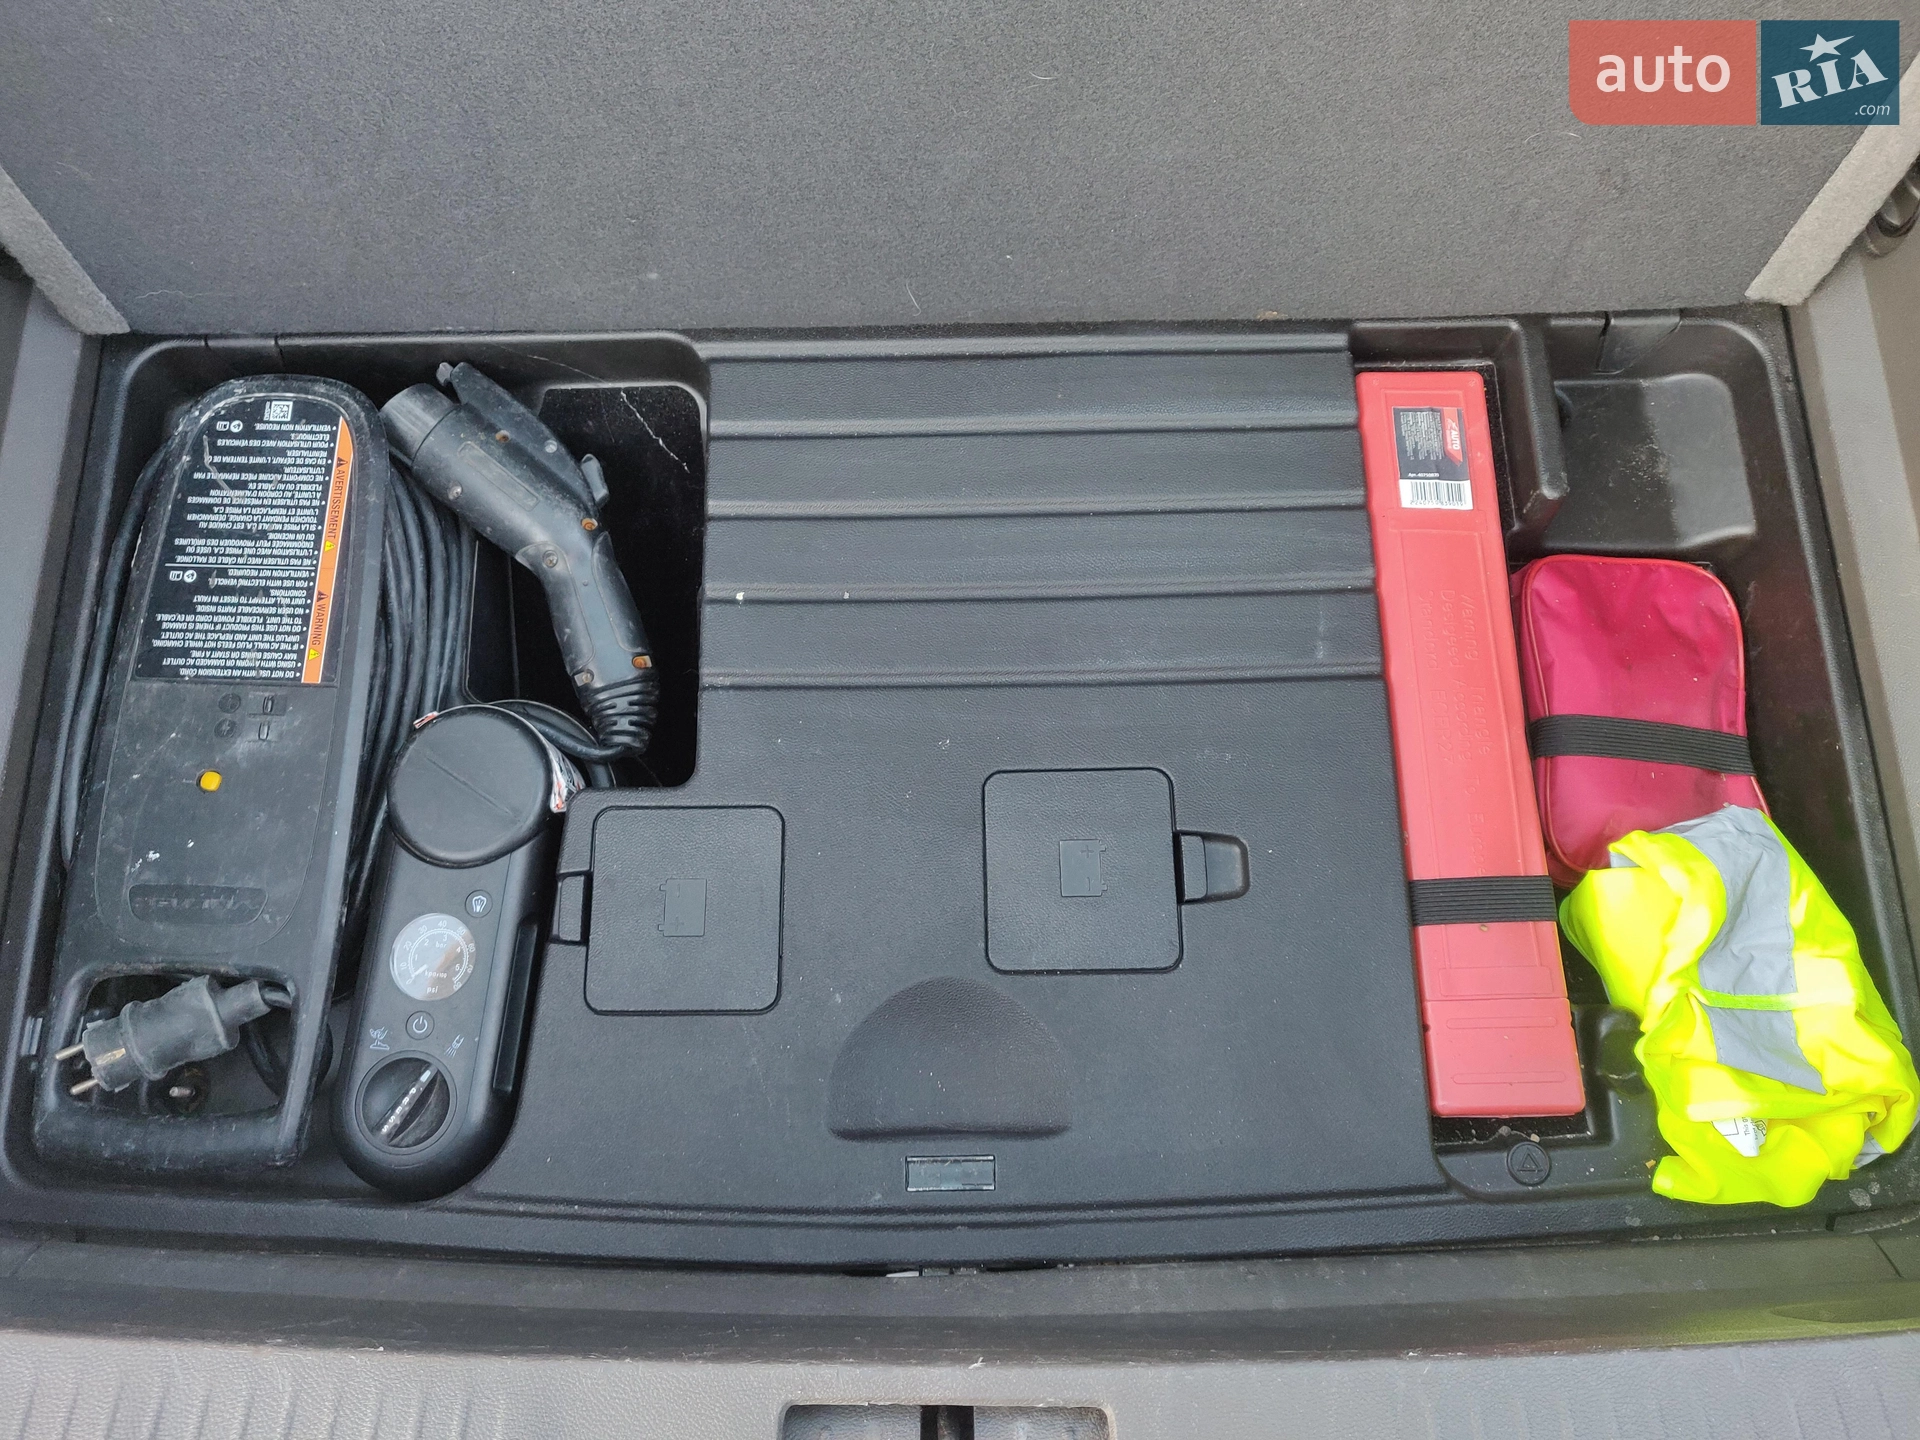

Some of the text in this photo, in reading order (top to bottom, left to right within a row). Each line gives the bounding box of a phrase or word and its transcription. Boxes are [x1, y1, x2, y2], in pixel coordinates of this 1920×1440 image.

[1450, 430, 1461, 450] AUTO
[327, 469, 345, 539] AVERTISSEMENT
[312, 603, 327, 646] WARNING
[198, 668, 231, 676] EXTENSION
[1471, 687, 1494, 755] Triangle
[437, 920, 447, 928] 40
[381, 1086, 417, 1135] PRESS
